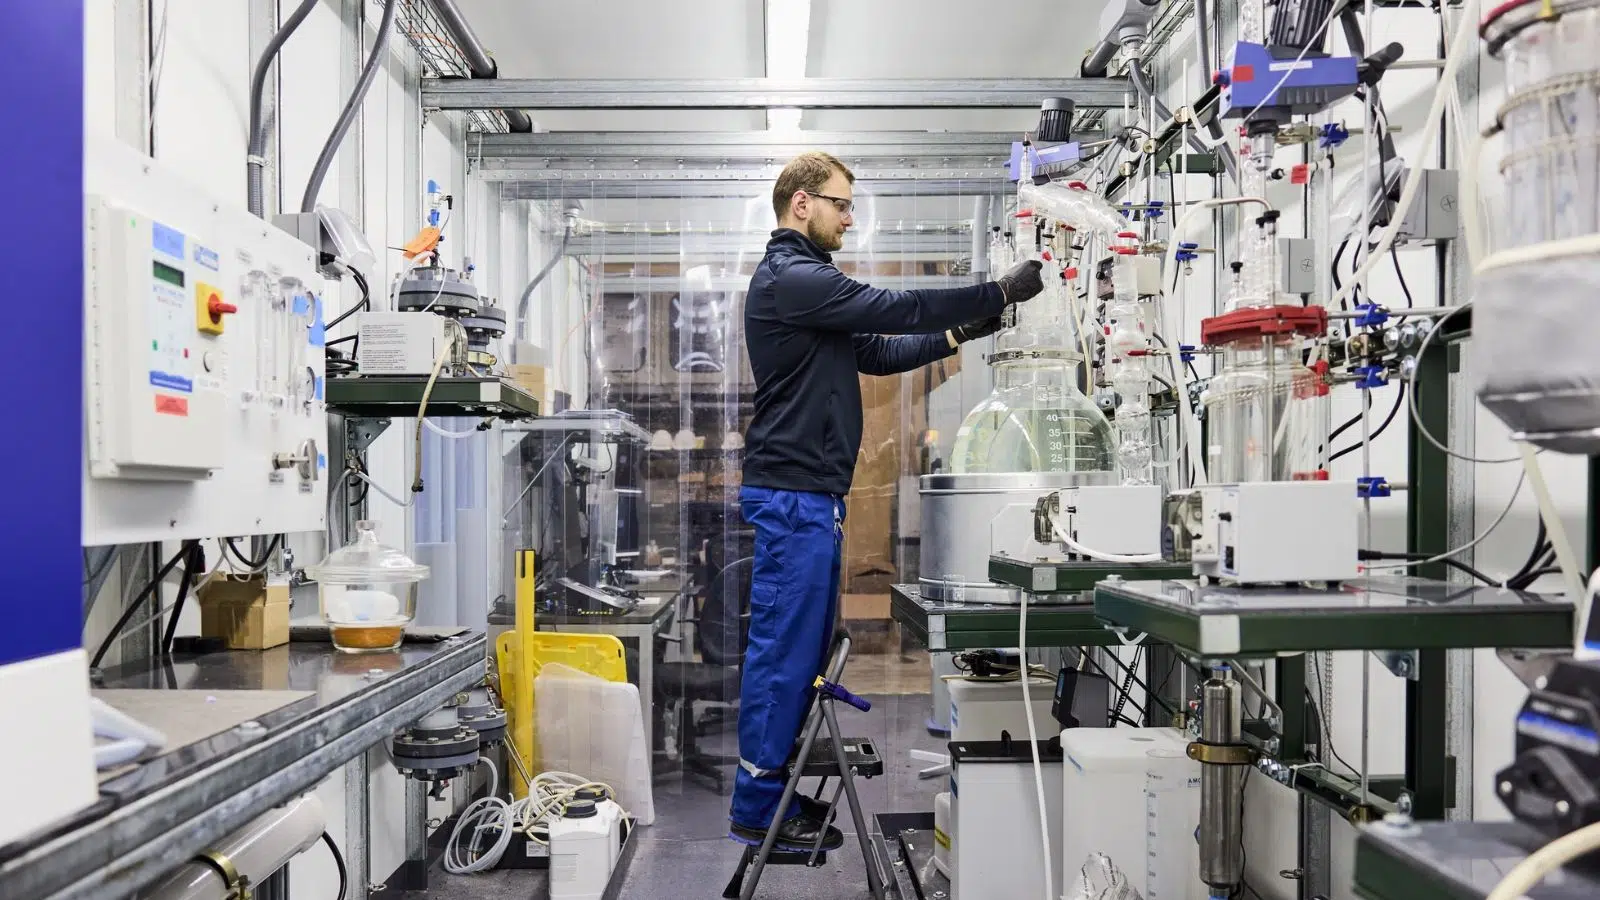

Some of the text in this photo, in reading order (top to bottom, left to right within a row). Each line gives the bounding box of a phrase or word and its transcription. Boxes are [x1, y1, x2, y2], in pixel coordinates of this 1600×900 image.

[1046, 414, 1058, 422] 40
[1048, 428, 1061, 437] 35
[1050, 441, 1062, 450] 30
[1051, 453, 1063, 463] 25
